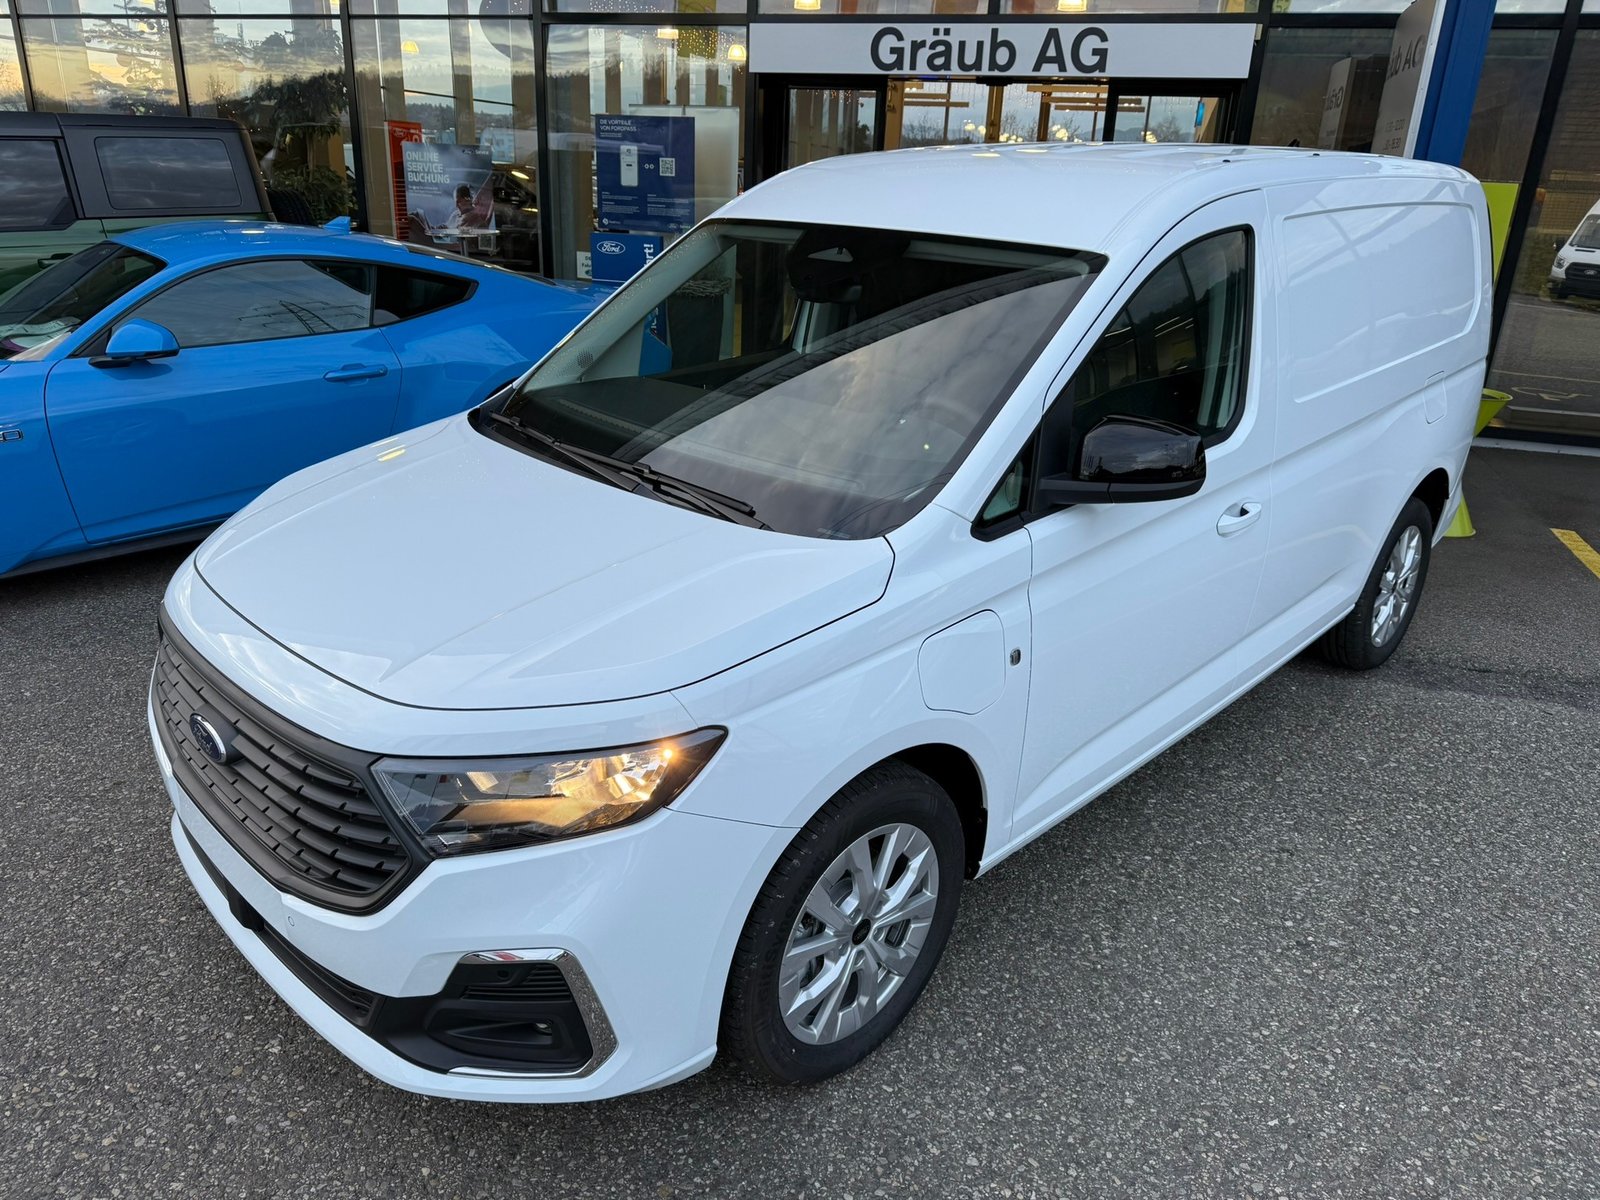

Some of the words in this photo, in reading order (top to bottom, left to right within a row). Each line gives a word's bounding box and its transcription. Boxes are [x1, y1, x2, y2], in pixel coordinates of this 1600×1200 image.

[870, 26, 1017, 73] Gräub
[1031, 26, 1109, 74] AG
[406, 151, 439, 162] ONLINE
[407, 162, 443, 173] SERVICE
[407, 172, 450, 184] BUCHUNG
[601, 241, 621, 253] Ford
